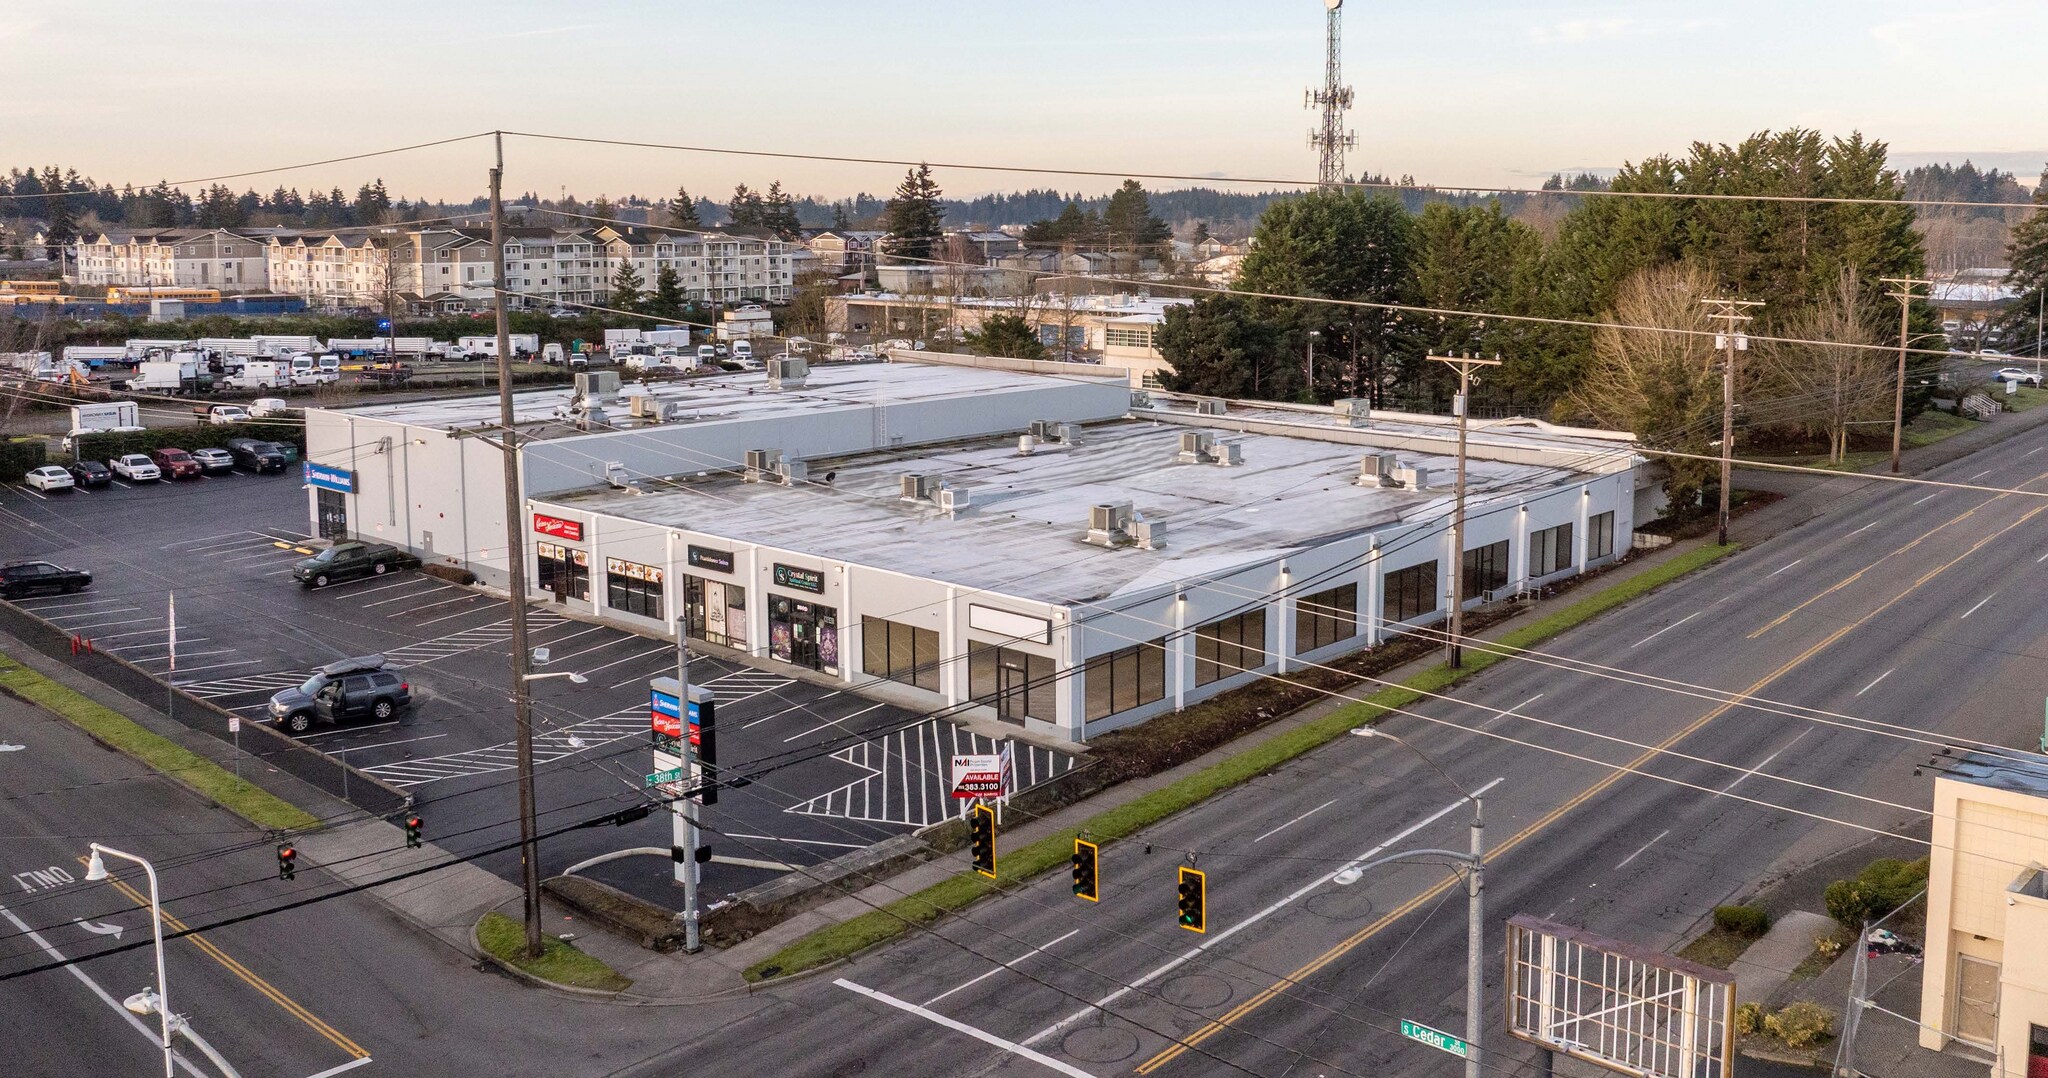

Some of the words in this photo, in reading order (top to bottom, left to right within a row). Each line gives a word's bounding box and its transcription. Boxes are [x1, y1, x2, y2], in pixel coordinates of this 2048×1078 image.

[787, 569, 804, 580] Crystal
[804, 573, 818, 582] Spirit
[955, 758, 970, 767] NAI
[654, 770, 673, 784] 38th
[12, 866, 75, 893] ONLY
[1412, 1026, 1446, 1047] Cedar
